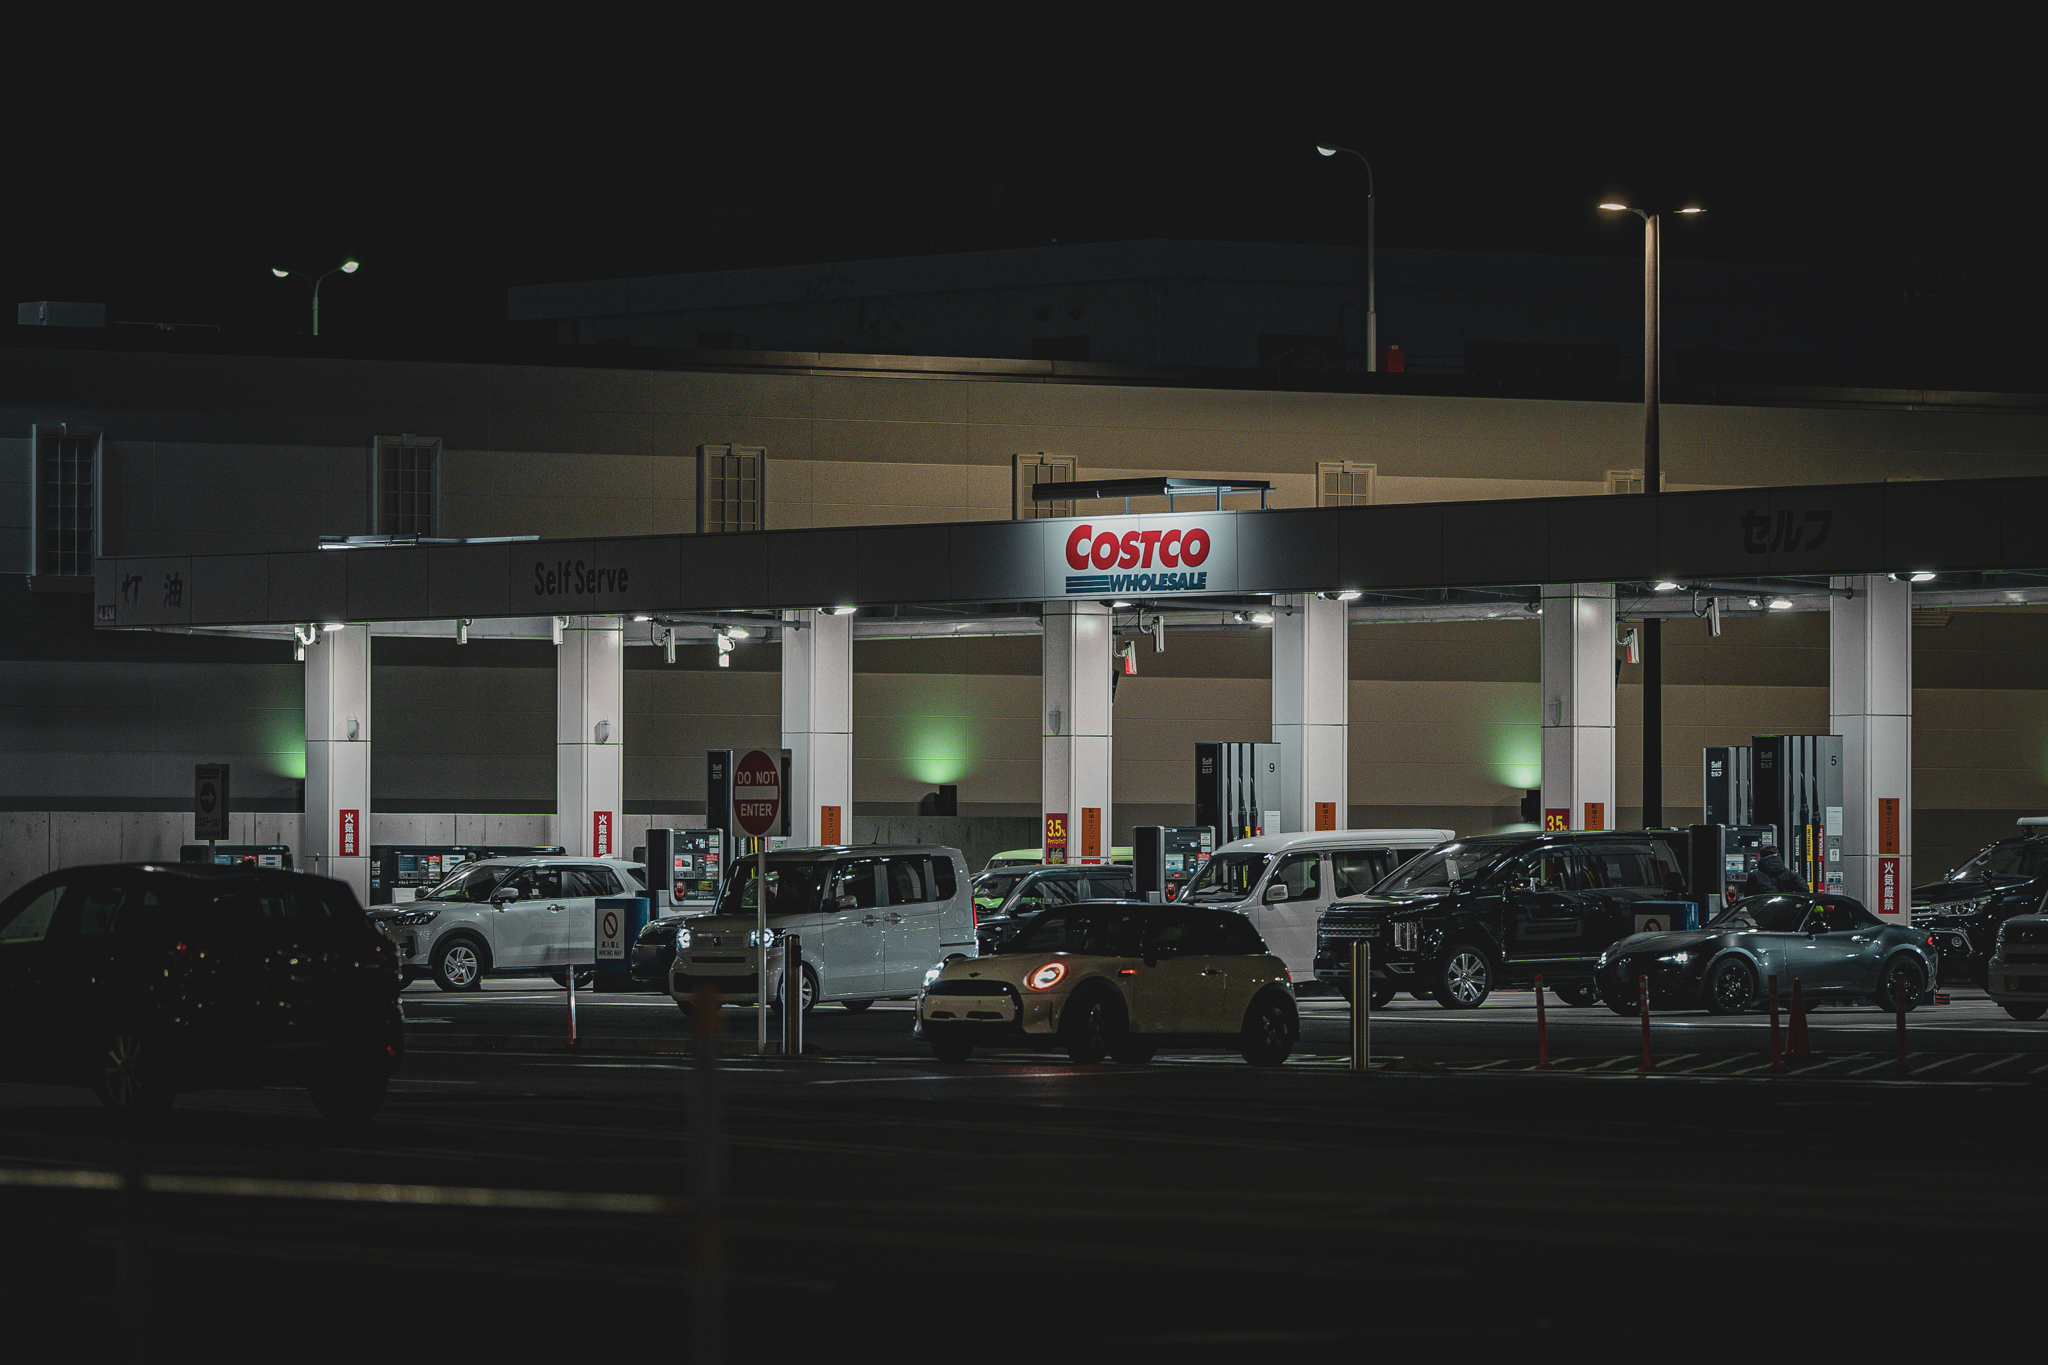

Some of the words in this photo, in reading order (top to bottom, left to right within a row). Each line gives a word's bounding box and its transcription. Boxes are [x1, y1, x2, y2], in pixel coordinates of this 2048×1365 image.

[1740, 509, 1834, 555] セルフ
[1065, 524, 1211, 571] COSTCO
[534, 560, 572, 596] Self
[574, 559, 629, 595] Serve
[1109, 571, 1208, 592] WHOLESALE
[98, 606, 115, 620] 4.2M
[1201, 757, 1213, 766] Self
[1710, 760, 1723, 769] Self
[1760, 751, 1773, 760] Self
[1830, 755, 1838, 767] 5
[1268, 762, 1276, 773] 9
[736, 771, 752, 785] DO
[756, 770, 776, 785] NOT
[740, 803, 773, 817] ENTER
[344, 812, 354, 853] 火気厳禁
[598, 814, 608, 855] 火気厳禁
[1047, 819, 1067, 837] 3.5%
[1885, 799, 1893, 855] 給油中エンジン停止
[1883, 861, 1895, 911] 火気厳禁
